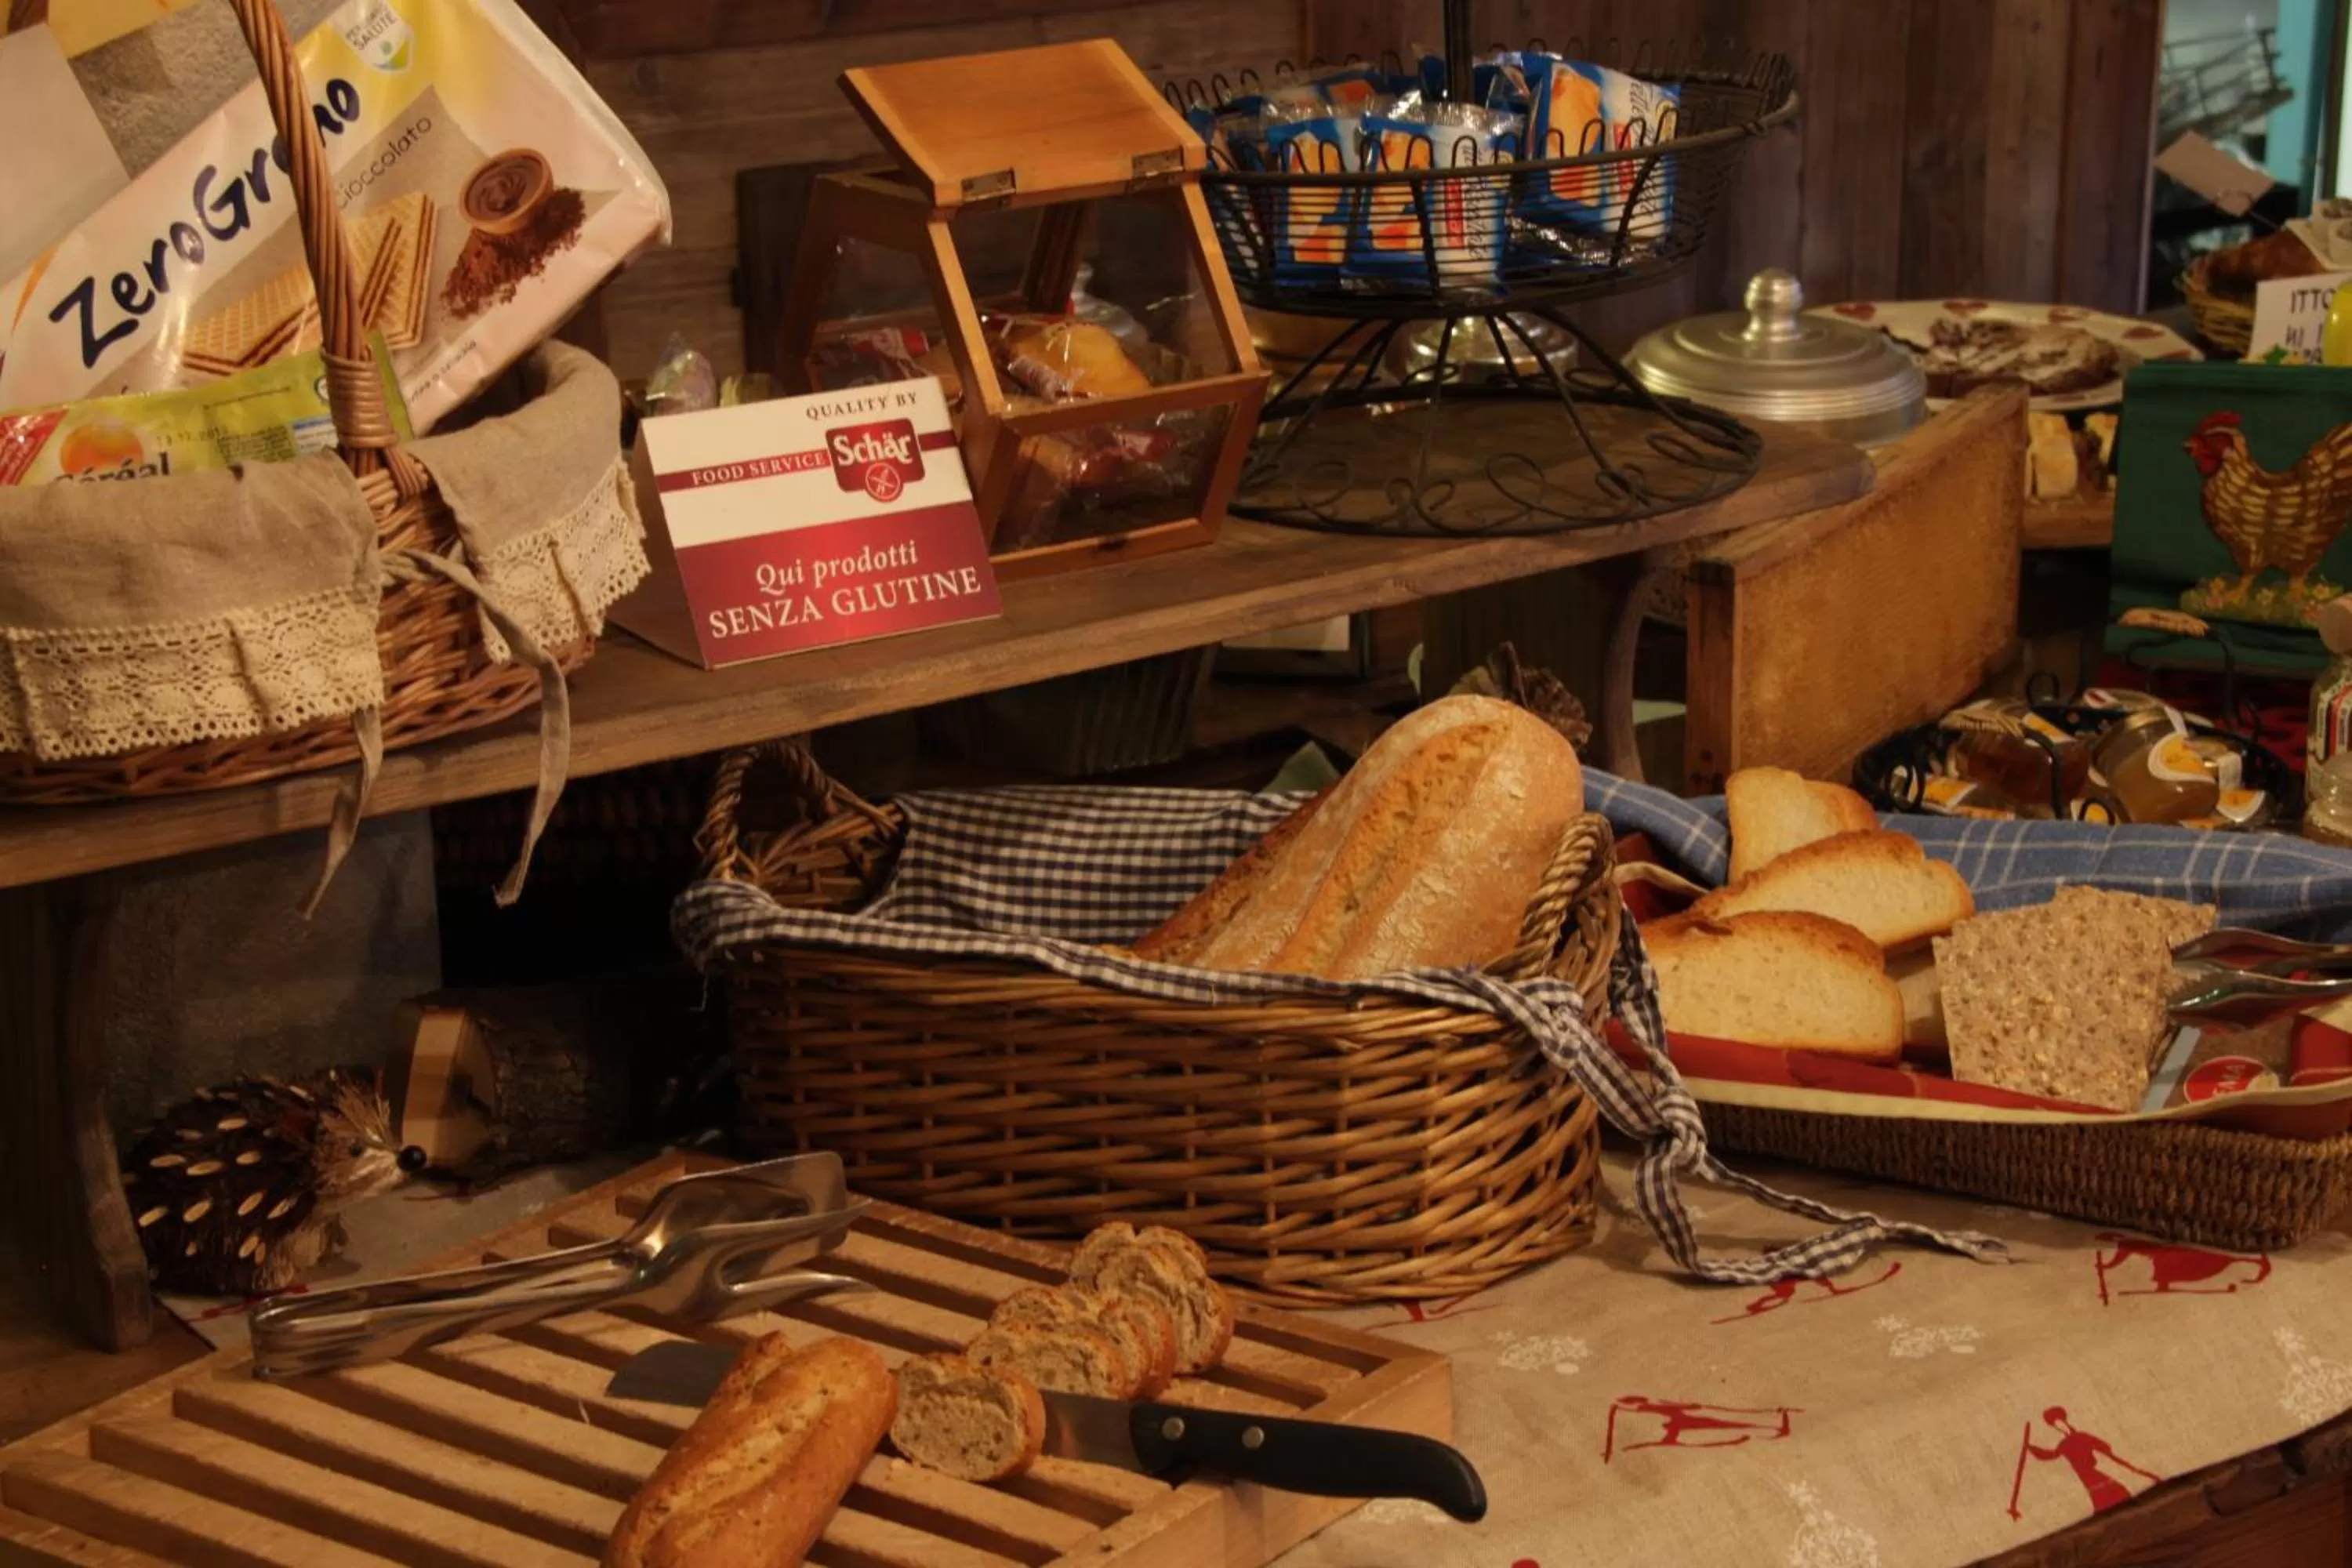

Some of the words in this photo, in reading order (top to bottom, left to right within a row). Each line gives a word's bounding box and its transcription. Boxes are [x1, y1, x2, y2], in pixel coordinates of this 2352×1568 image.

[353, 12, 398, 51] SALUTE
[337, 116, 433, 209] cioccolato
[806, 395, 888, 419] QUALITY
[897, 391, 918, 408] BY
[54, 452, 170, 483] éal
[691, 463, 745, 486] FOOD
[749, 451, 826, 476] SERVICE
[833, 432, 913, 468] Schär
[756, 562, 804, 596] Qui
[812, 539, 918, 589] prodotti
[709, 600, 823, 639] SENZA
[831, 566, 982, 617] GLUTINE
